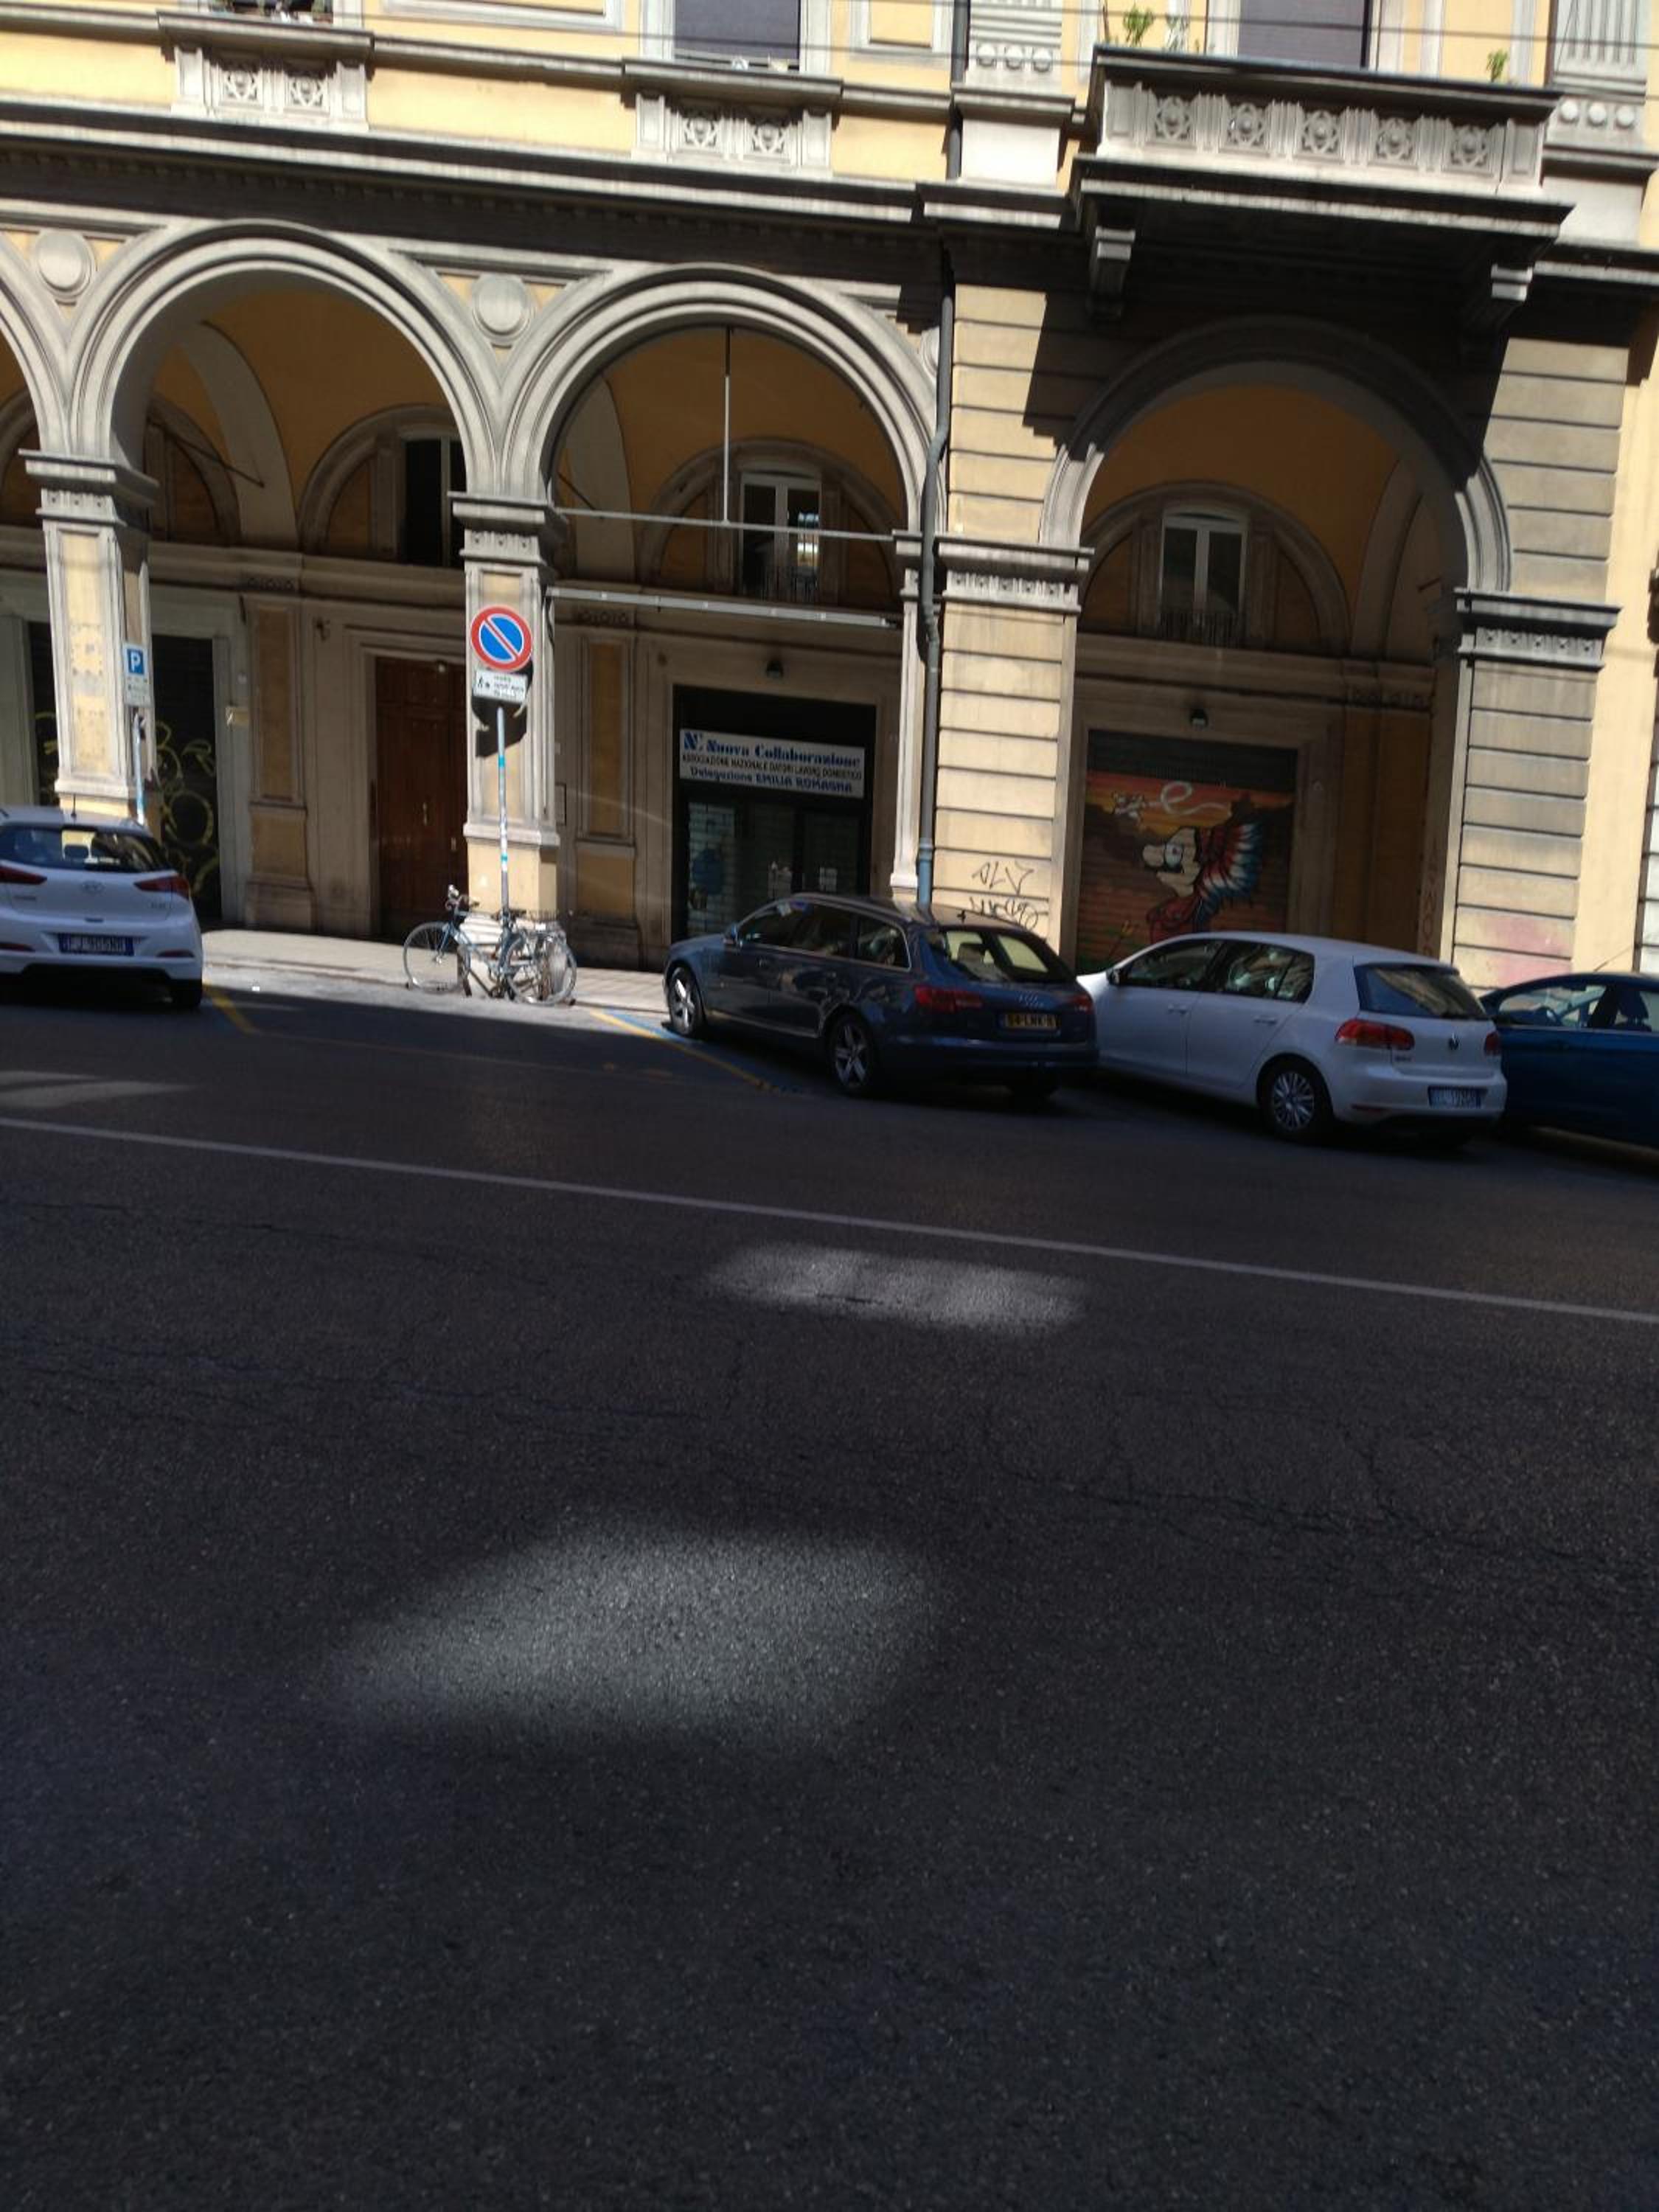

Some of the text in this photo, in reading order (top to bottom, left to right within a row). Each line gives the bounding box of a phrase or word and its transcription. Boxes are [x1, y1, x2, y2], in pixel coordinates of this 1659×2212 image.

[131, 650, 141, 673] P
[706, 740, 750, 756] Nuova
[754, 744, 860, 768] Collaborazione
[730, 758, 768, 771] NAZIONALE
[690, 766, 852, 793] Delegazione EMILIA ROMAGNA
